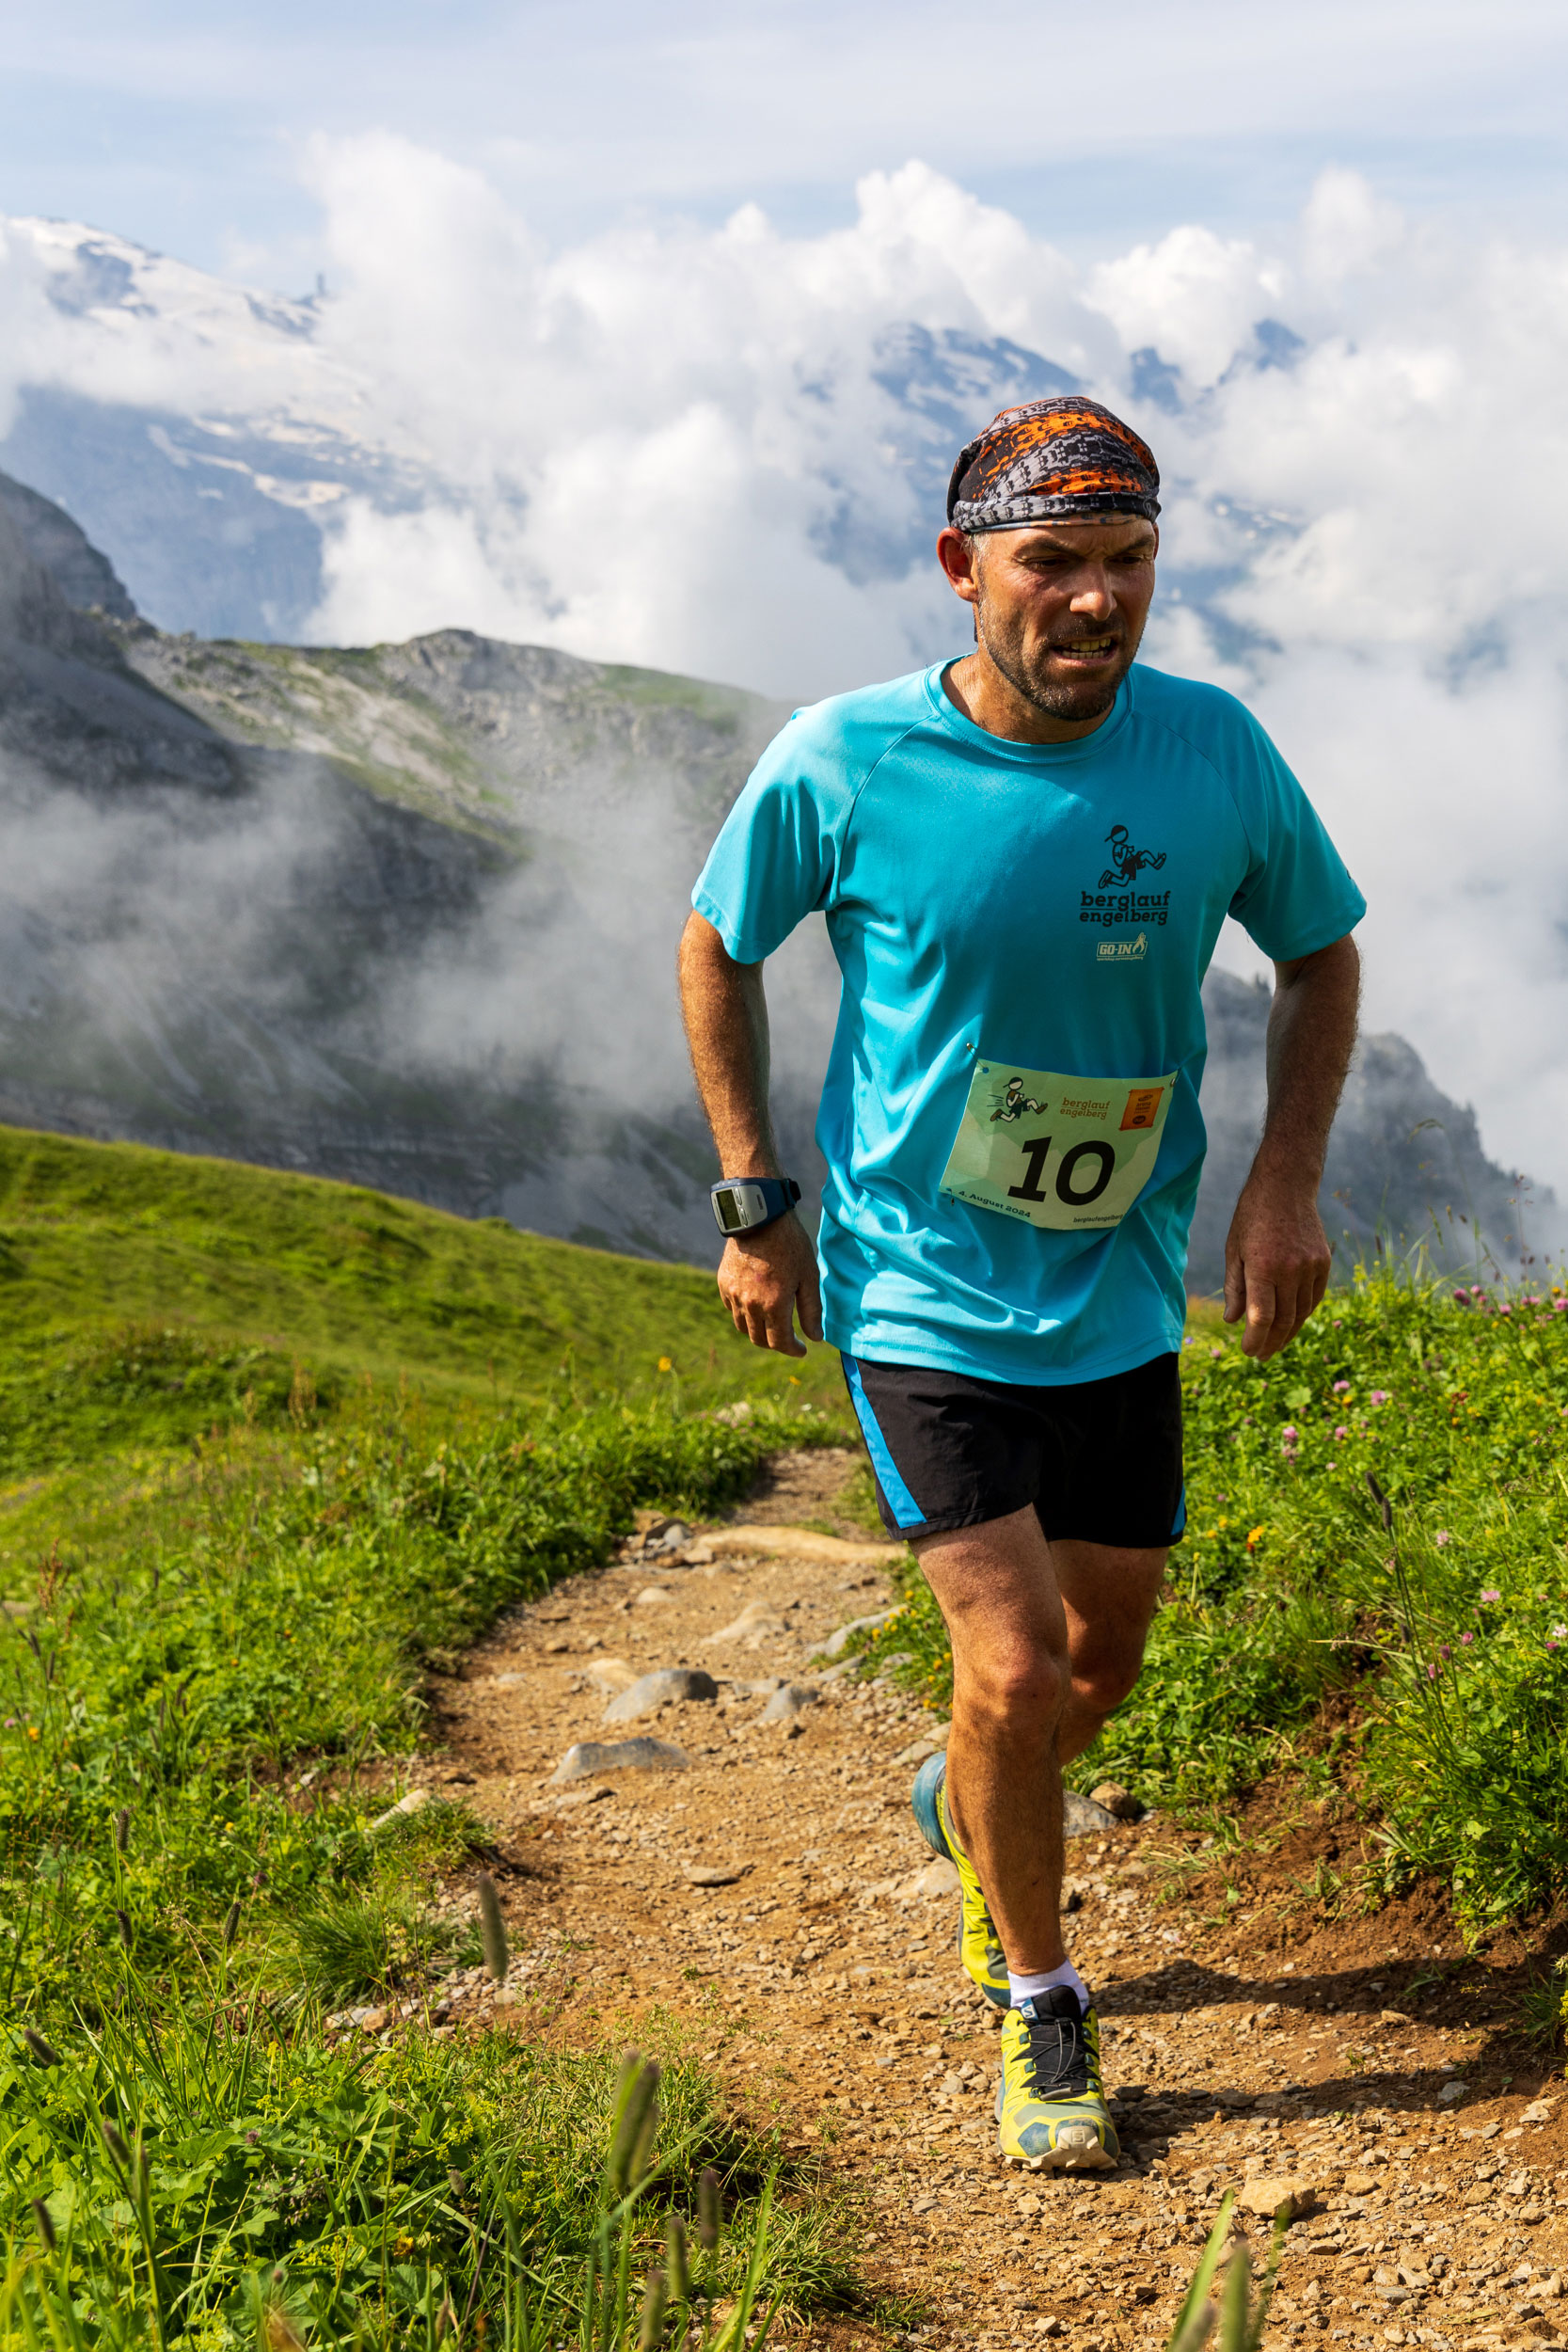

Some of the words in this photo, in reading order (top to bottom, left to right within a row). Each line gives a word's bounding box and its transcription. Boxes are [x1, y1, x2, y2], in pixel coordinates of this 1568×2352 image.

[1080, 890, 1171, 911] berglauf
[1079, 909, 1168, 927] engelberg
[1099, 944, 1133, 956] GO-IN
[1062, 1096, 1112, 1111] berglauf
[1059, 1108, 1108, 1120] engelberg
[1007, 1136, 1116, 1206] 10
[969, 1193, 1005, 1209] August
[1005, 1205, 1032, 1218] 2024
